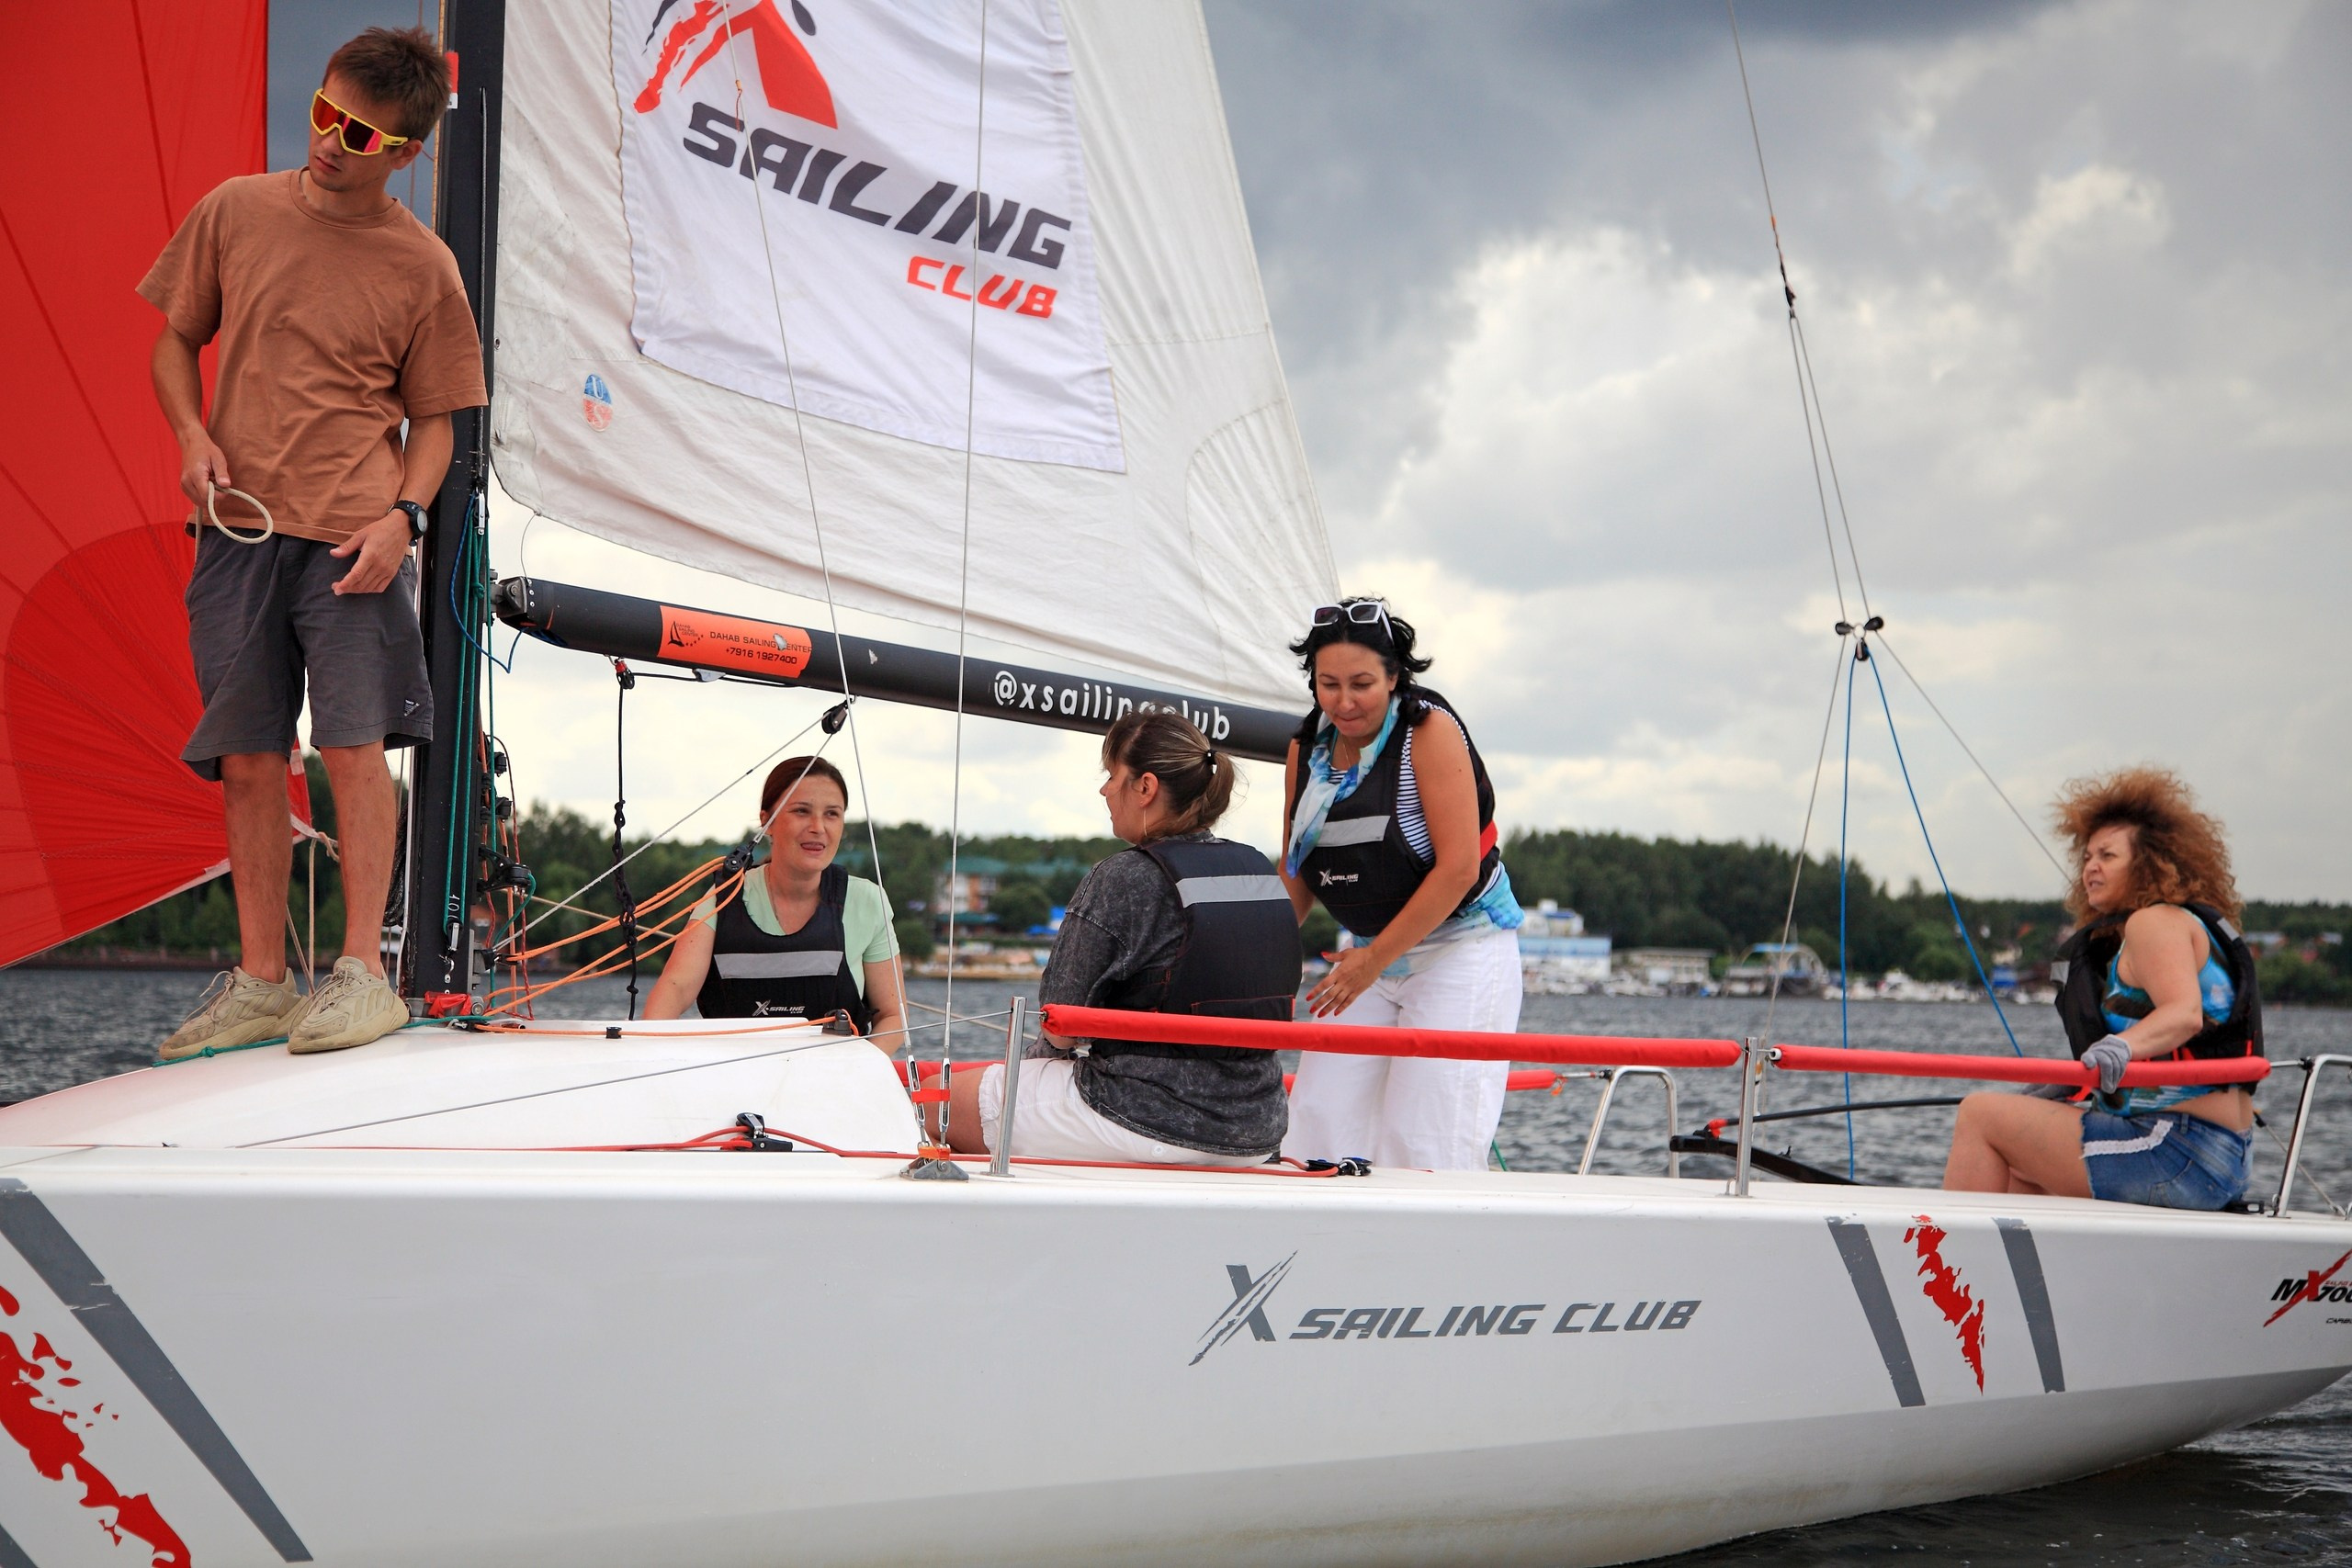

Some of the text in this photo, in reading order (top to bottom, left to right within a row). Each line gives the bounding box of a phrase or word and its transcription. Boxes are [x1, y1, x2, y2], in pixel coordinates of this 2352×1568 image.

[683, 101, 1072, 270] SAILING
[907, 255, 1058, 320] CLUB
[710, 631, 812, 653] DAHAB SAILING ENTER
[726, 647, 797, 665] +7916 1927400
[1289, 1303, 1546, 1340] SAILING
[1553, 1300, 1702, 1333] CLUB
